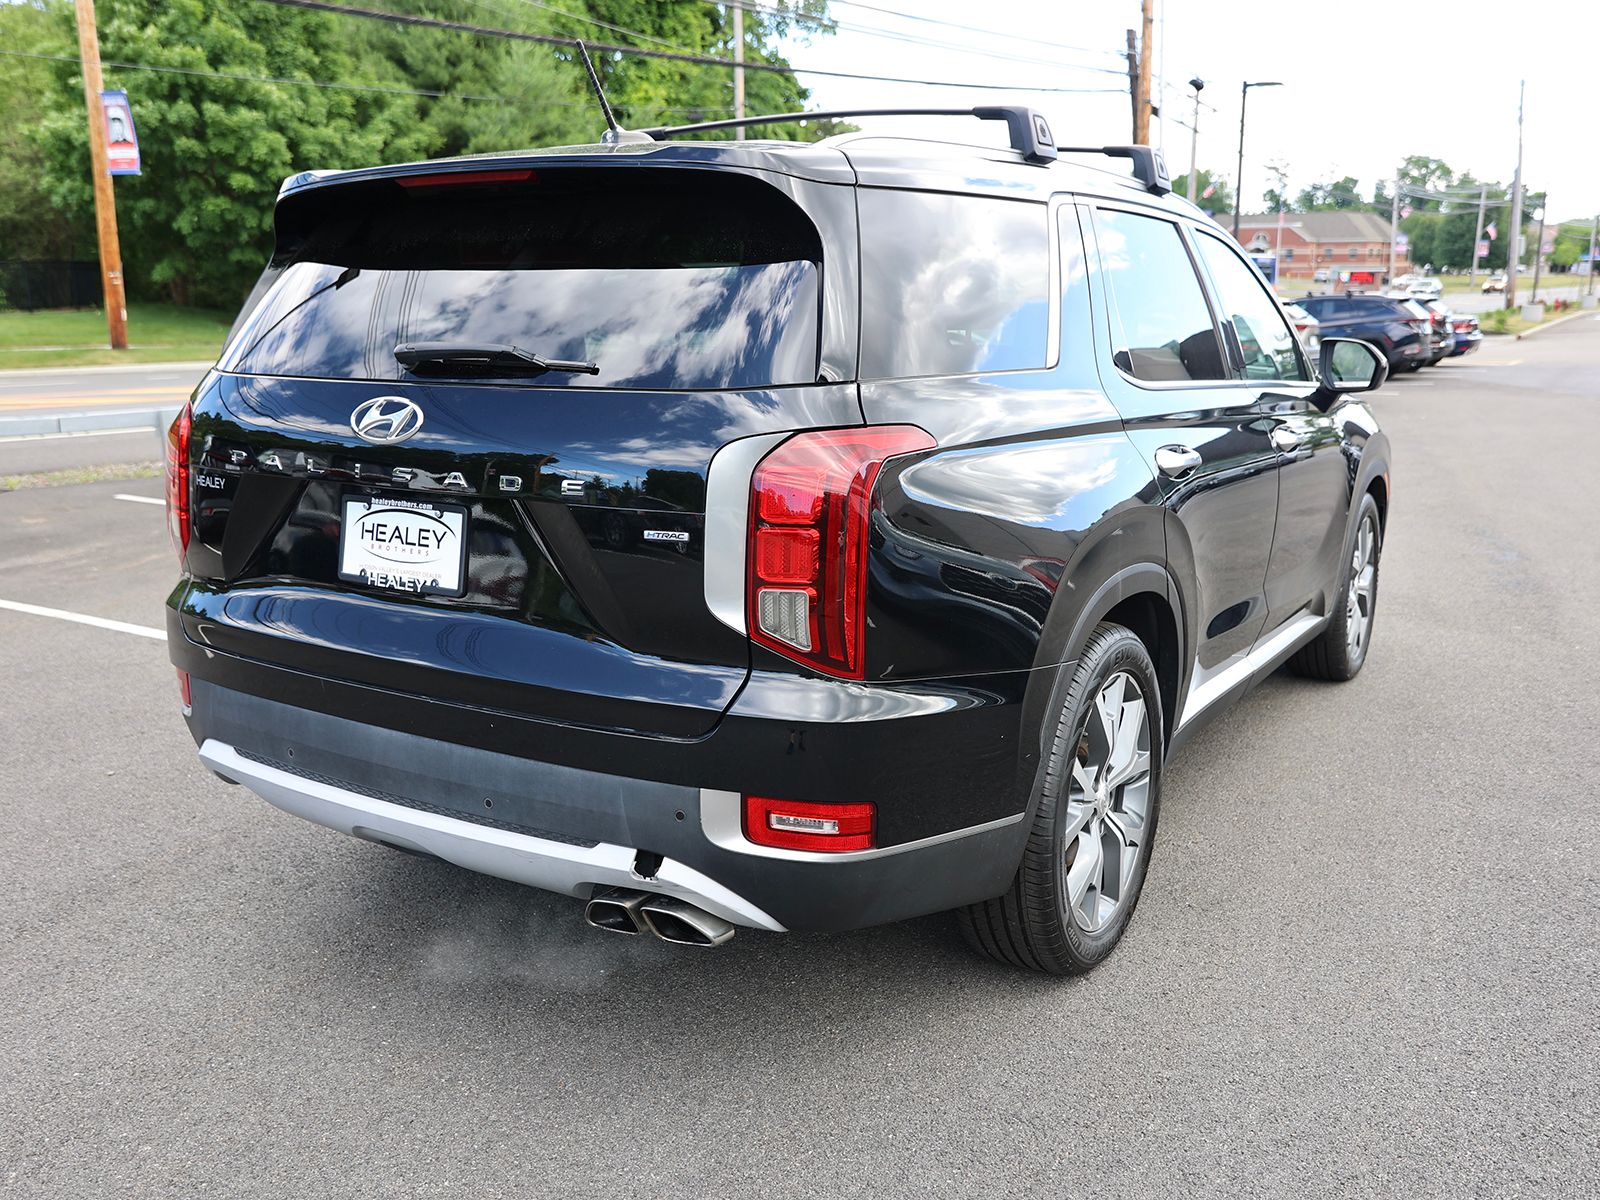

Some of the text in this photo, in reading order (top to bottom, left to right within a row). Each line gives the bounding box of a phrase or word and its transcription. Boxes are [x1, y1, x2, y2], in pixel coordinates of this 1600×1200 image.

[229, 449, 587, 497] PALISADE
[196, 475, 226, 490] HEALEY
[371, 496, 433, 510] healeybrothers.com
[361, 521, 448, 549] HEALEY
[645, 531, 686, 540] HTRAC
[371, 543, 430, 557] BROTHERS
[367, 572, 427, 593] HEALEY
